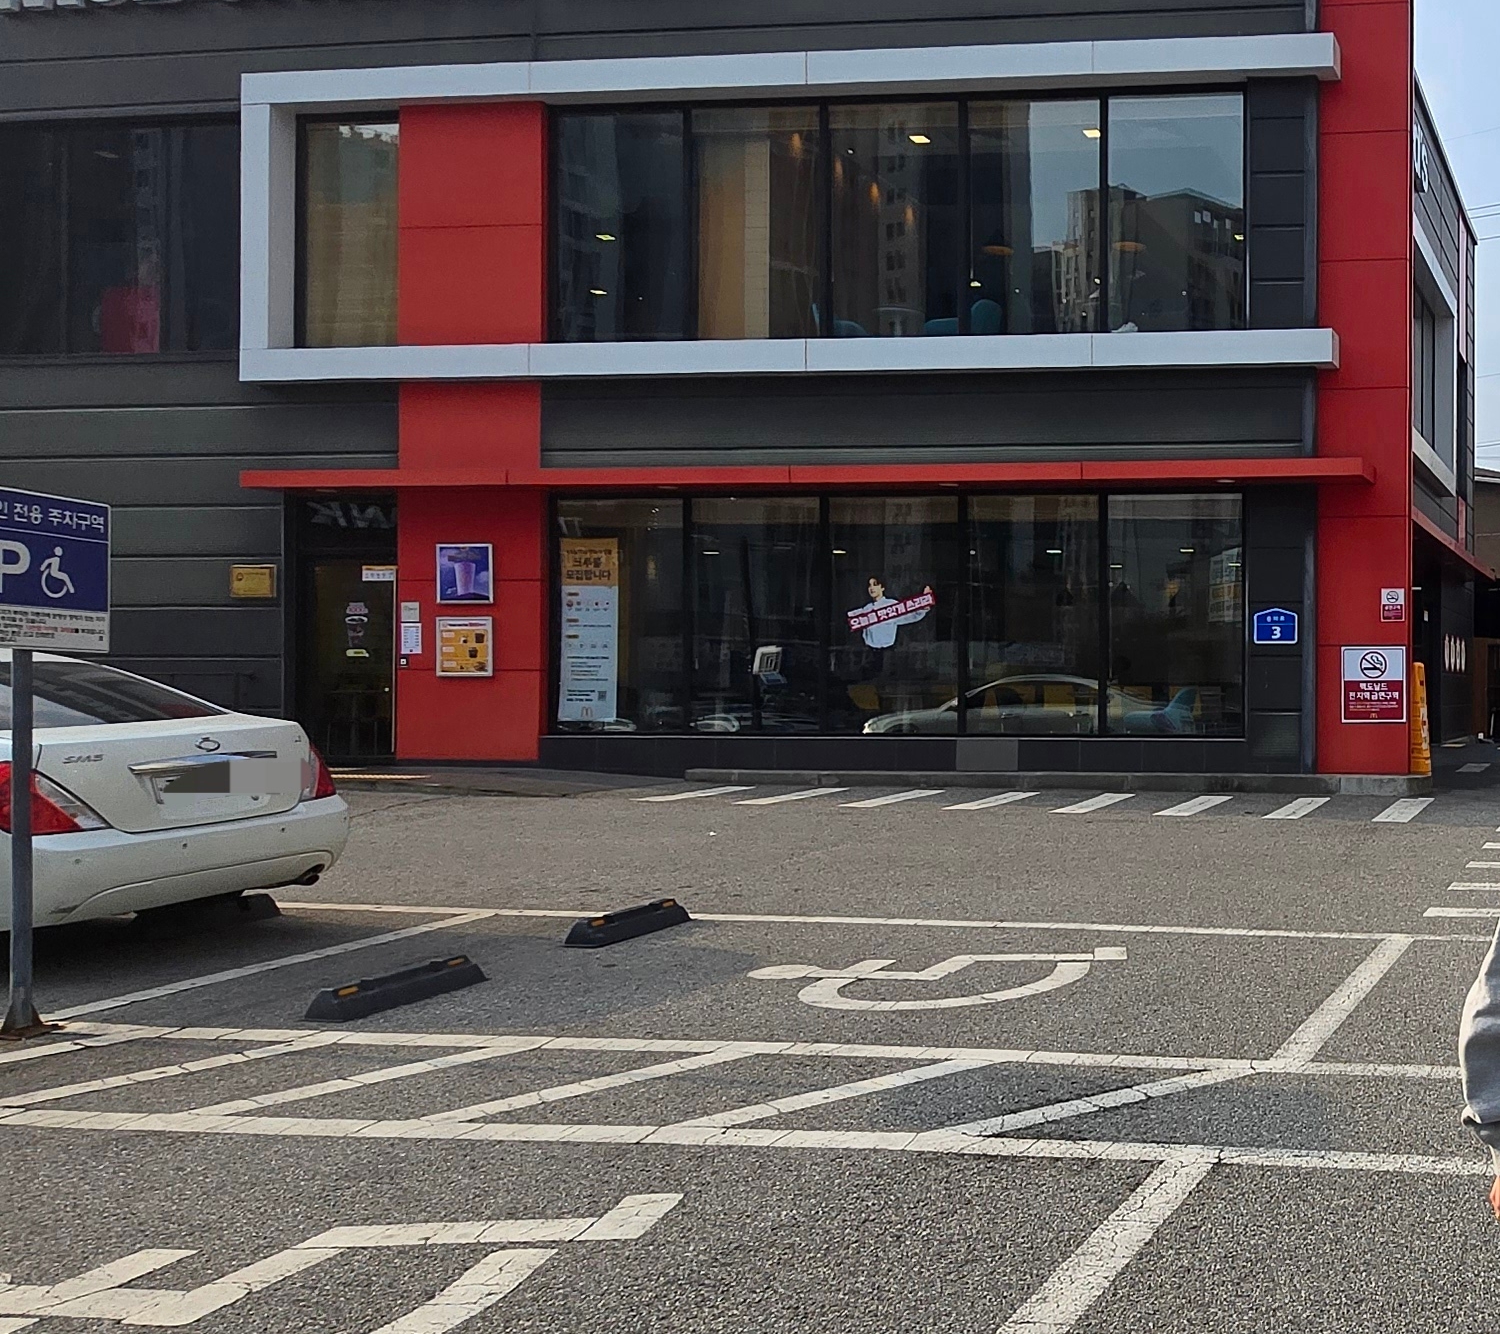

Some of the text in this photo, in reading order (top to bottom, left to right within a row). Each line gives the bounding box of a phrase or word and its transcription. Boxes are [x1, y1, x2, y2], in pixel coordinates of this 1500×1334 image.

[13, 503, 43, 524] 전용
[48, 508, 104, 533] 주차구역
[1271, 626, 1281, 639] 3
[1359, 682, 1388, 691] 맥도날드
[1371, 692, 1399, 700] 금연구역
